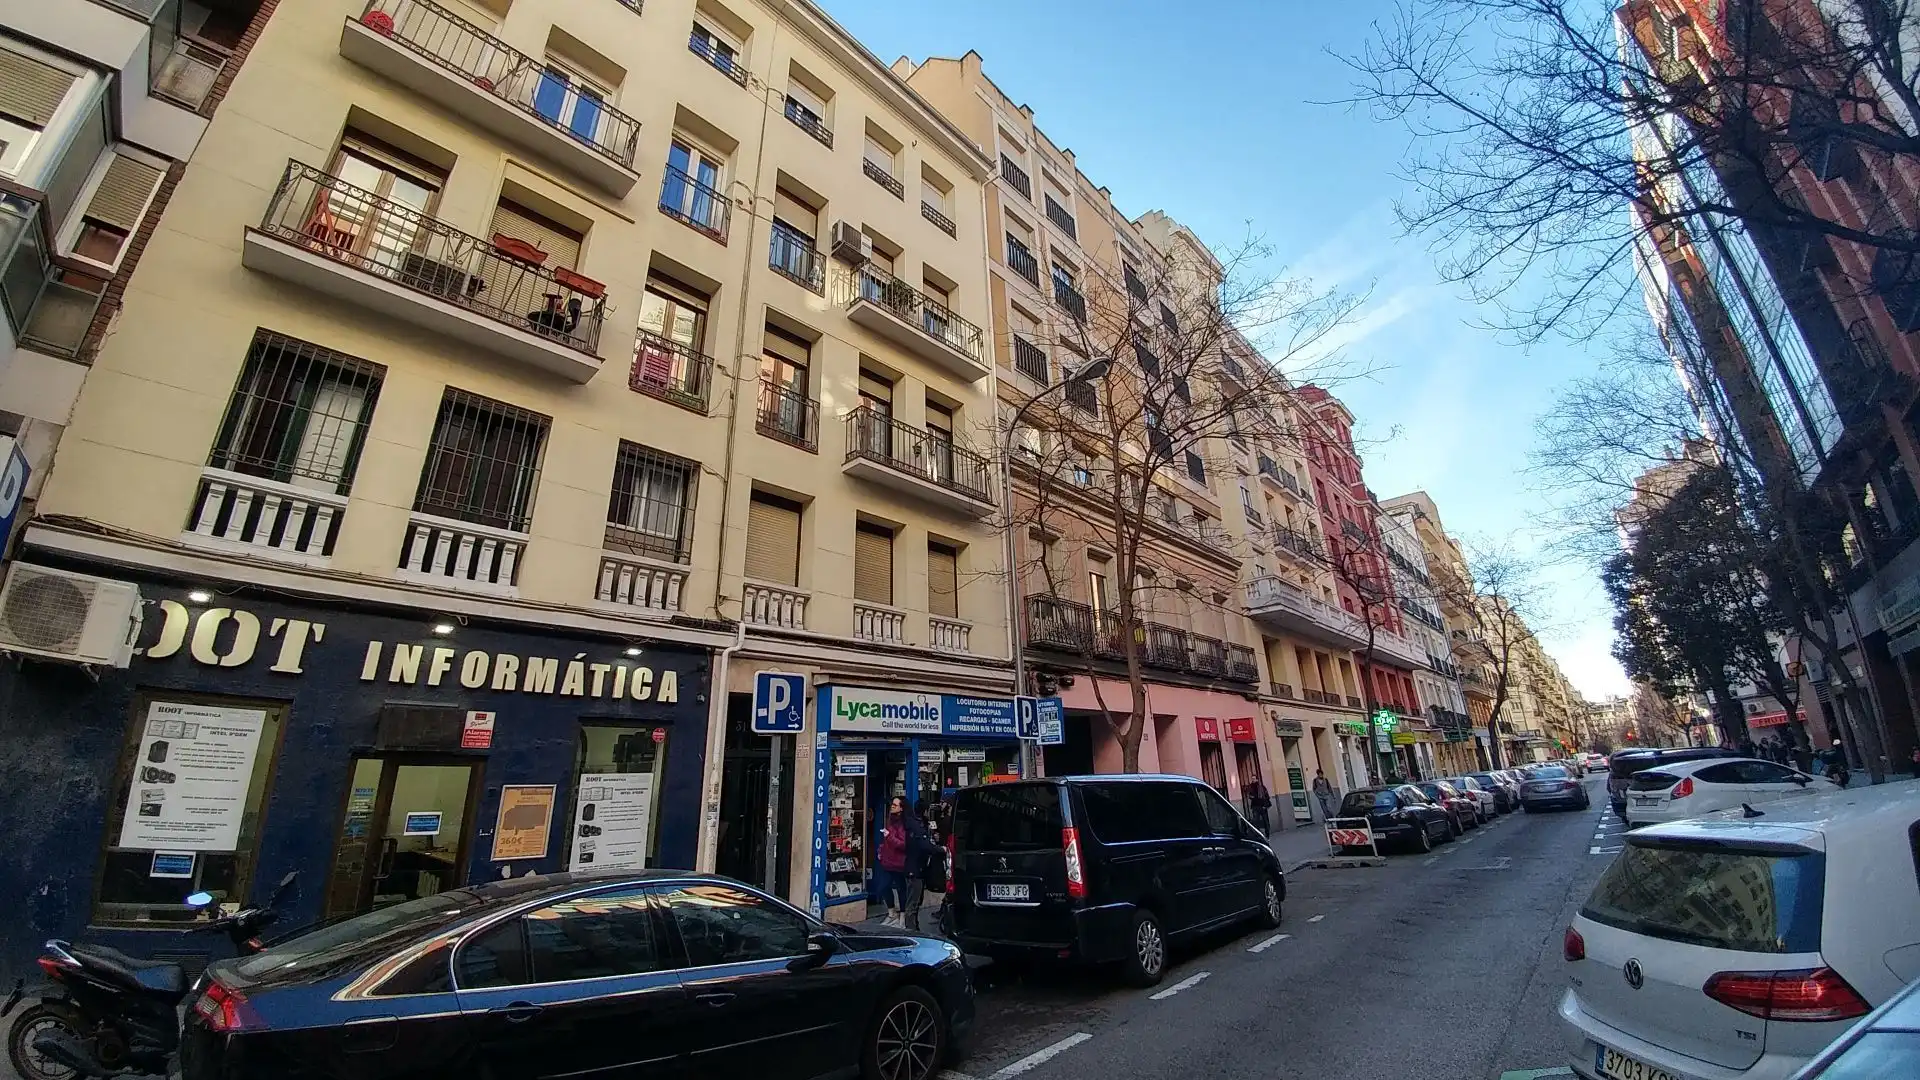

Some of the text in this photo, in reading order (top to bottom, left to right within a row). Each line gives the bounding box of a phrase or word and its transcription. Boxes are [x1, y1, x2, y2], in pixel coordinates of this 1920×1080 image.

[360, 640, 679, 704] INFORMÁTICA
[767, 677, 791, 725] P
[956, 698, 1012, 709] LOCUTORIO INTERNET
[157, 706, 184, 715] ROOT
[836, 695, 939, 721] Lycamobile
[969, 707, 1002, 716] FOTOCOPIAS
[959, 715, 988, 724] RECARGAS
[1021, 699, 1033, 734] P
[881, 720, 893, 729] Call
[894, 721, 904, 729] the
[904, 722, 920, 730] world
[949, 723, 980, 732] IMPRESIÓN
[1003, 726, 1017, 734] COLO
[812, 751, 826, 904] LOCUTORIO
[991, 885, 1029, 897] 3063 JFG
[1606, 1048, 1642, 1080] 3703
